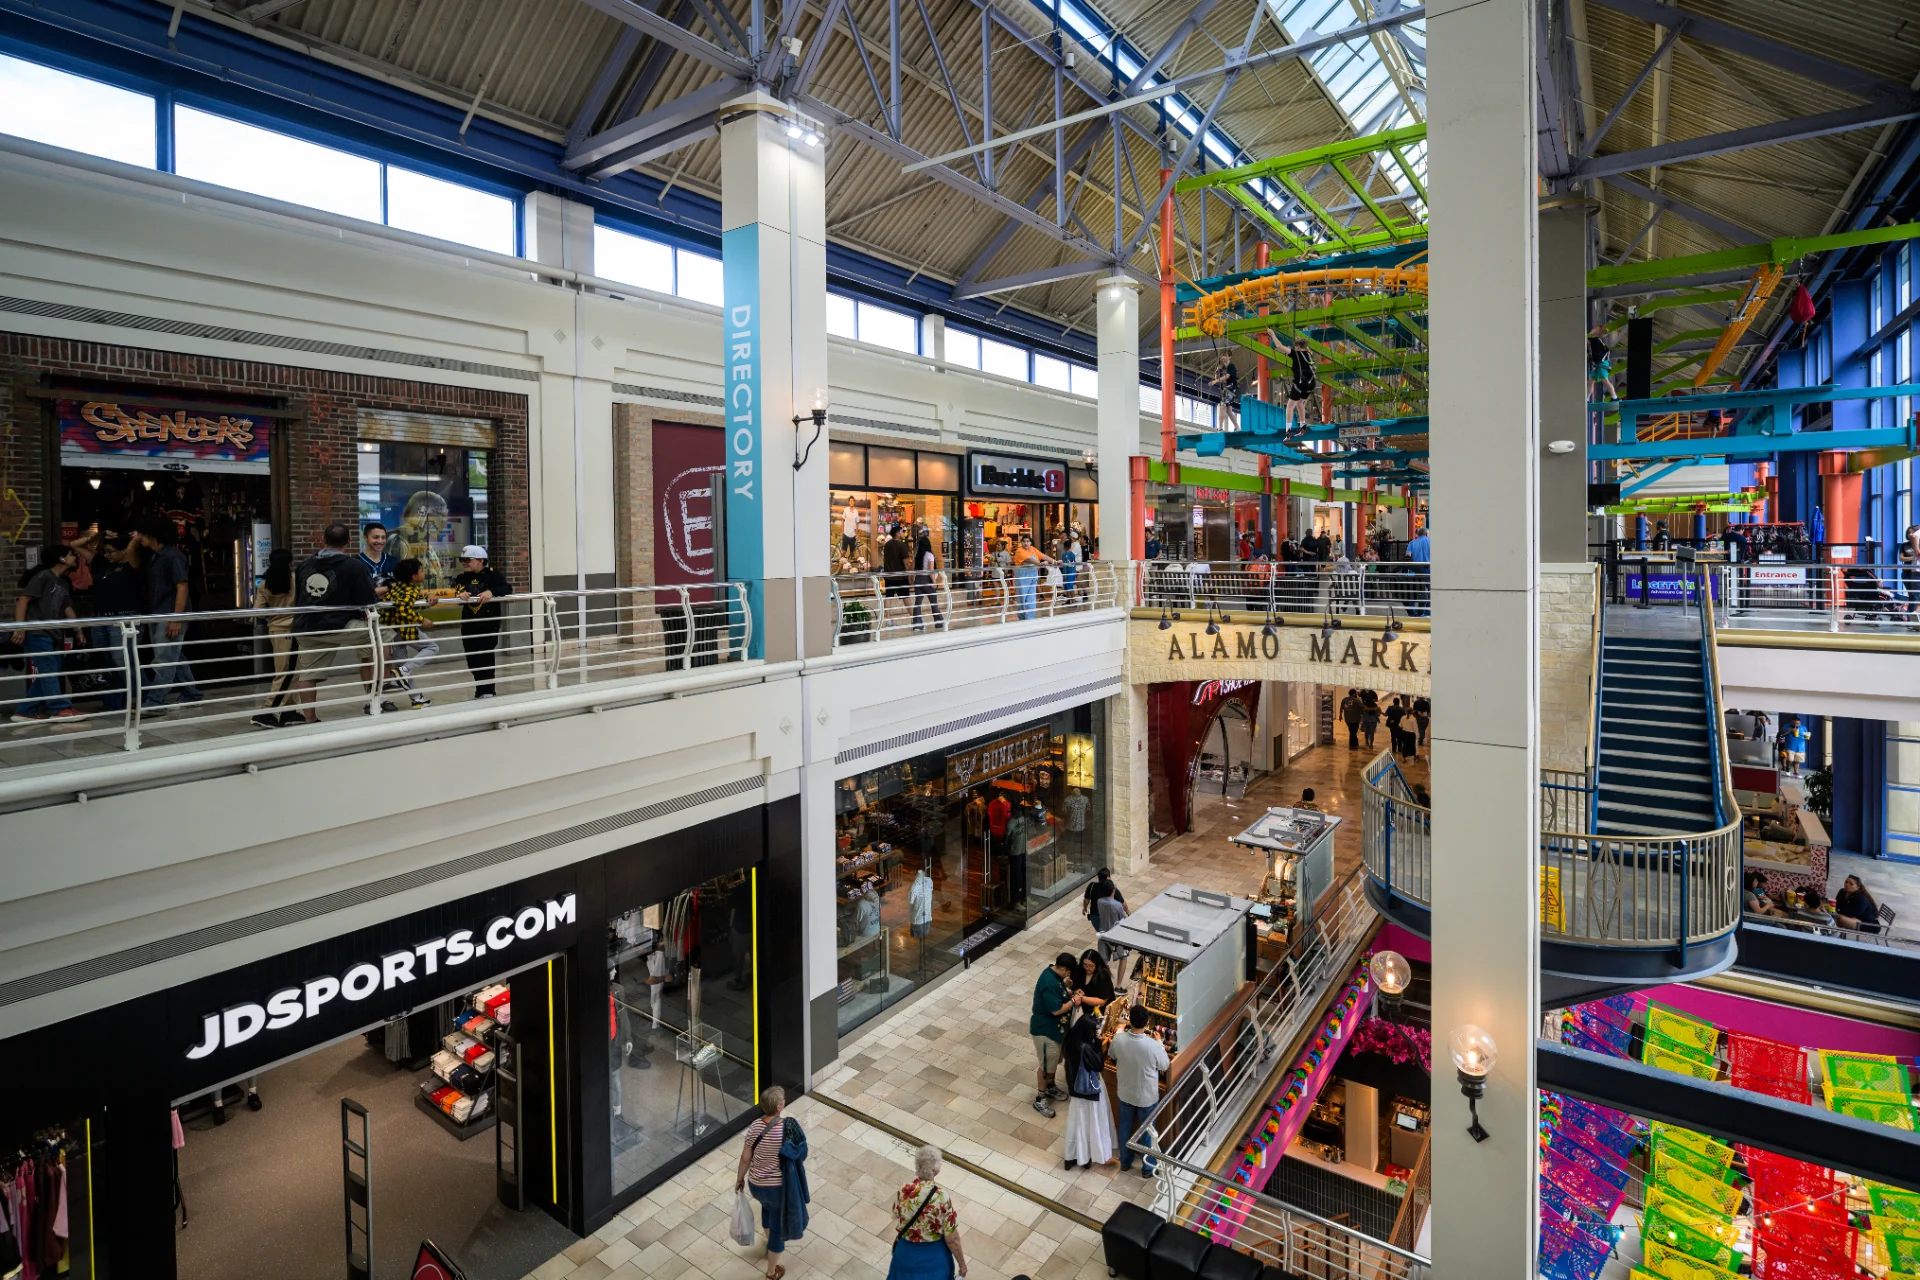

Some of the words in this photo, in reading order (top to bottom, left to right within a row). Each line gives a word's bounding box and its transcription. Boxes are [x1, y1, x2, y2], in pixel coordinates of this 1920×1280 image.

[731, 305, 754, 501] DIRECTORY
[981, 465, 1046, 489] Buckle
[1168, 632, 1280, 660] ALAMO
[1309, 633, 1431, 674] MARK
[982, 738, 1029, 774] BUNKER
[1031, 733, 1044, 755] 27
[185, 892, 577, 1060] JDSPORTS.COM
